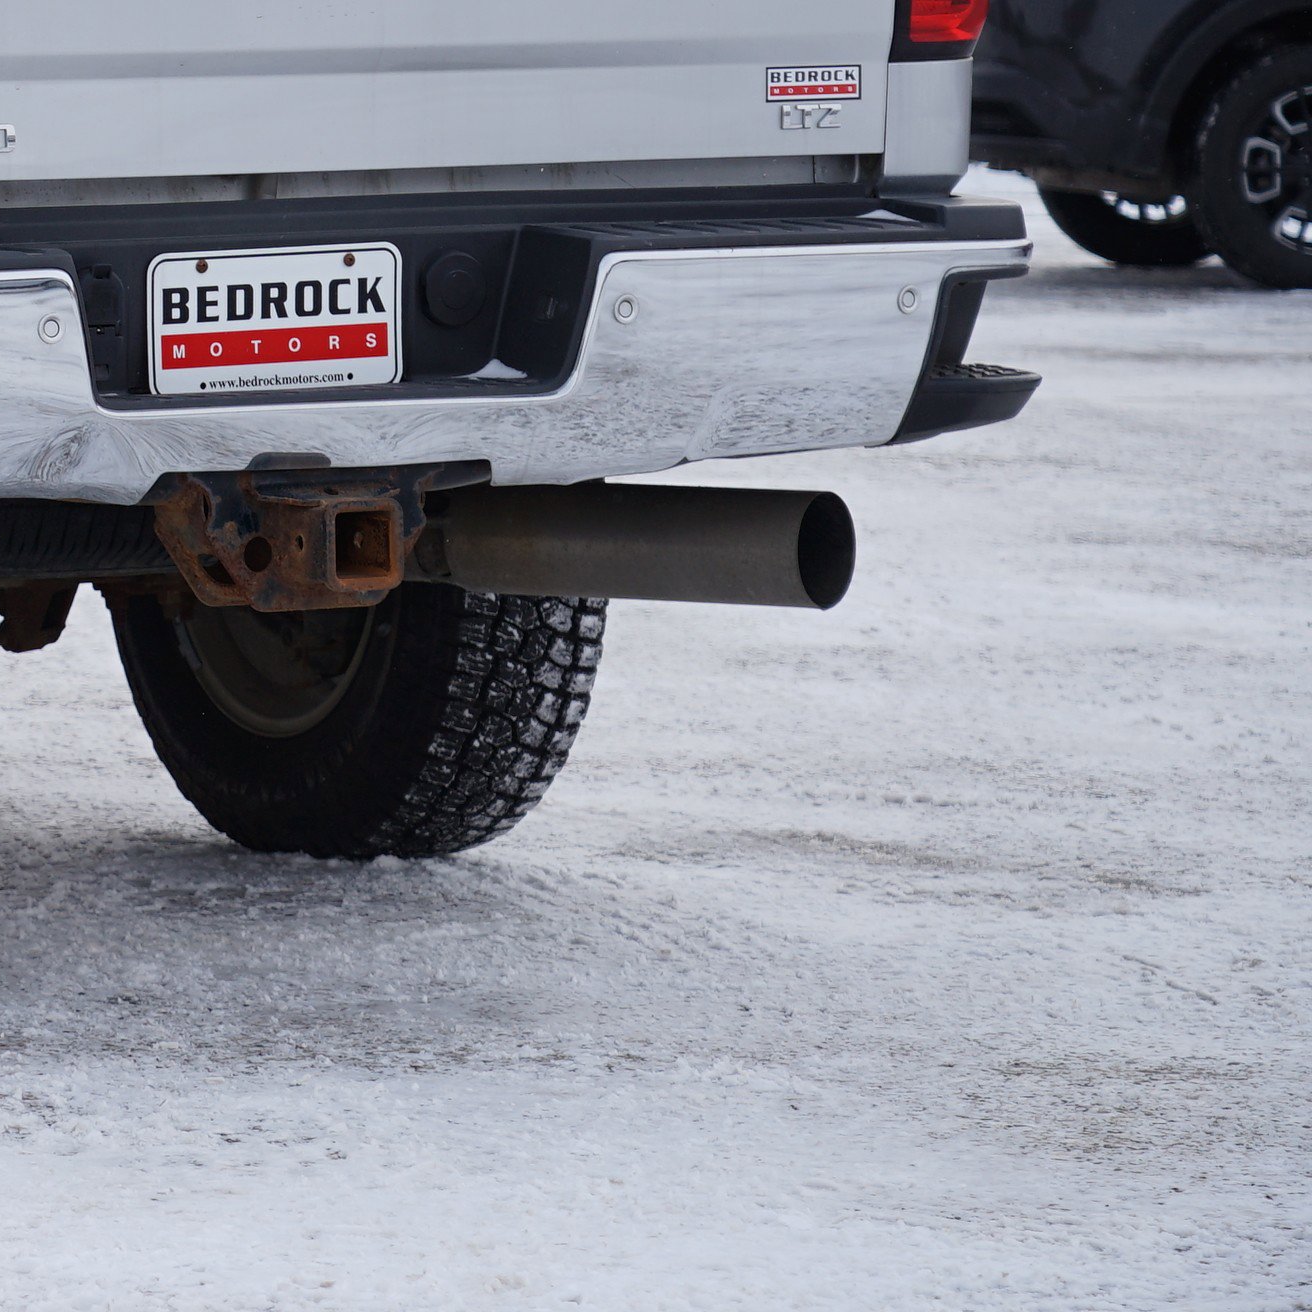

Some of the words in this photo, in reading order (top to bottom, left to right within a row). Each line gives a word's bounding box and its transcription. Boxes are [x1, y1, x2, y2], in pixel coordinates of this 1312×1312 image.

[770, 70, 856, 83] BEDROCK
[774, 85, 853, 94] MOTORS
[780, 103, 842, 129] LTZ
[162, 276, 386, 325] BEDROCK
[172, 332, 377, 359] MOTORS
[209, 372, 344, 389] www.bedrockmotors.com
